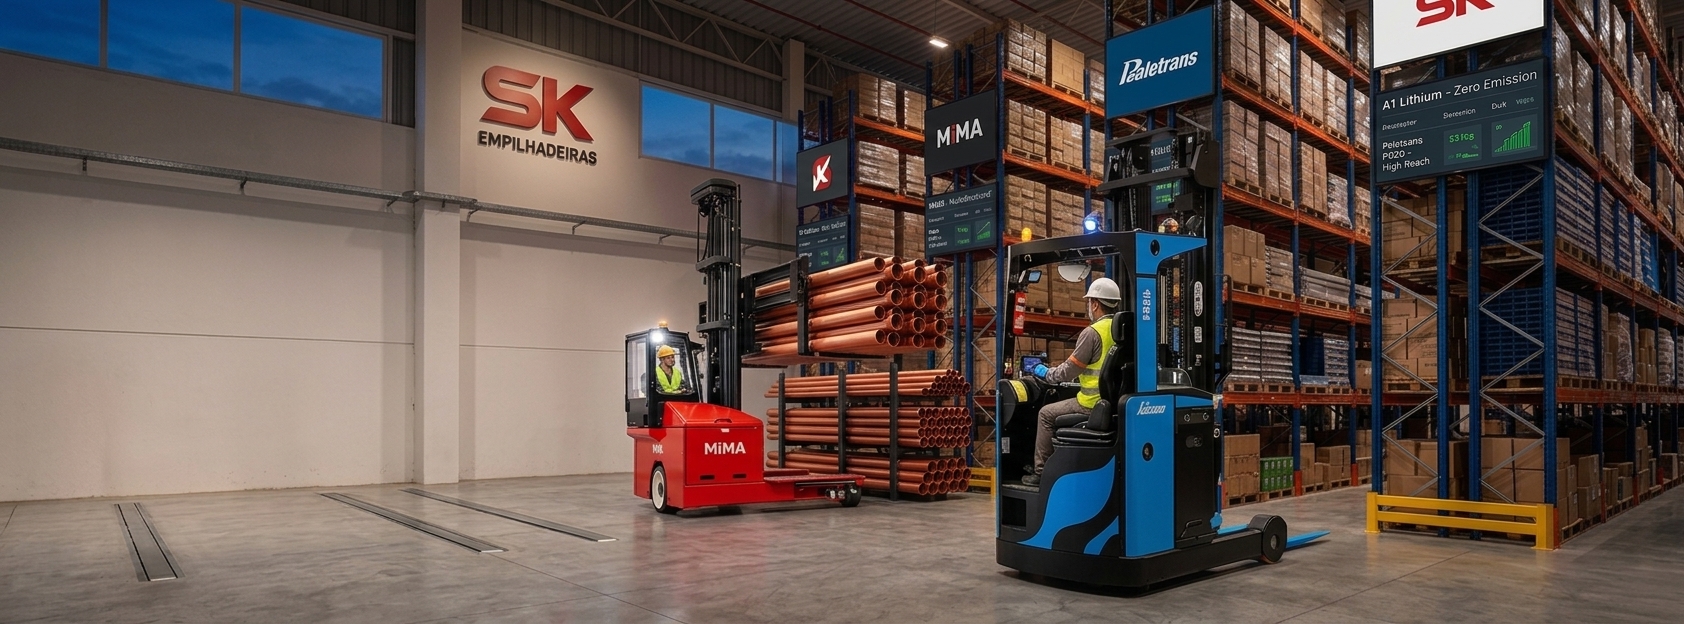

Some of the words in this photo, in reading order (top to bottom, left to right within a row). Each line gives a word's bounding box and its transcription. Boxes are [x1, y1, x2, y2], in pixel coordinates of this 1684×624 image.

[480, 65, 594, 142] SK
[1382, 98, 1396, 111] A1
[1400, 90, 1442, 107] Lithium
[1454, 82, 1481, 96] Zero
[1484, 70, 1537, 90] Emission
[478, 130, 596, 165] EMPILHADEIRAS
[1382, 161, 1402, 172] High
[1404, 156, 1430, 169] Reach
[704, 442, 746, 455] MiMA
